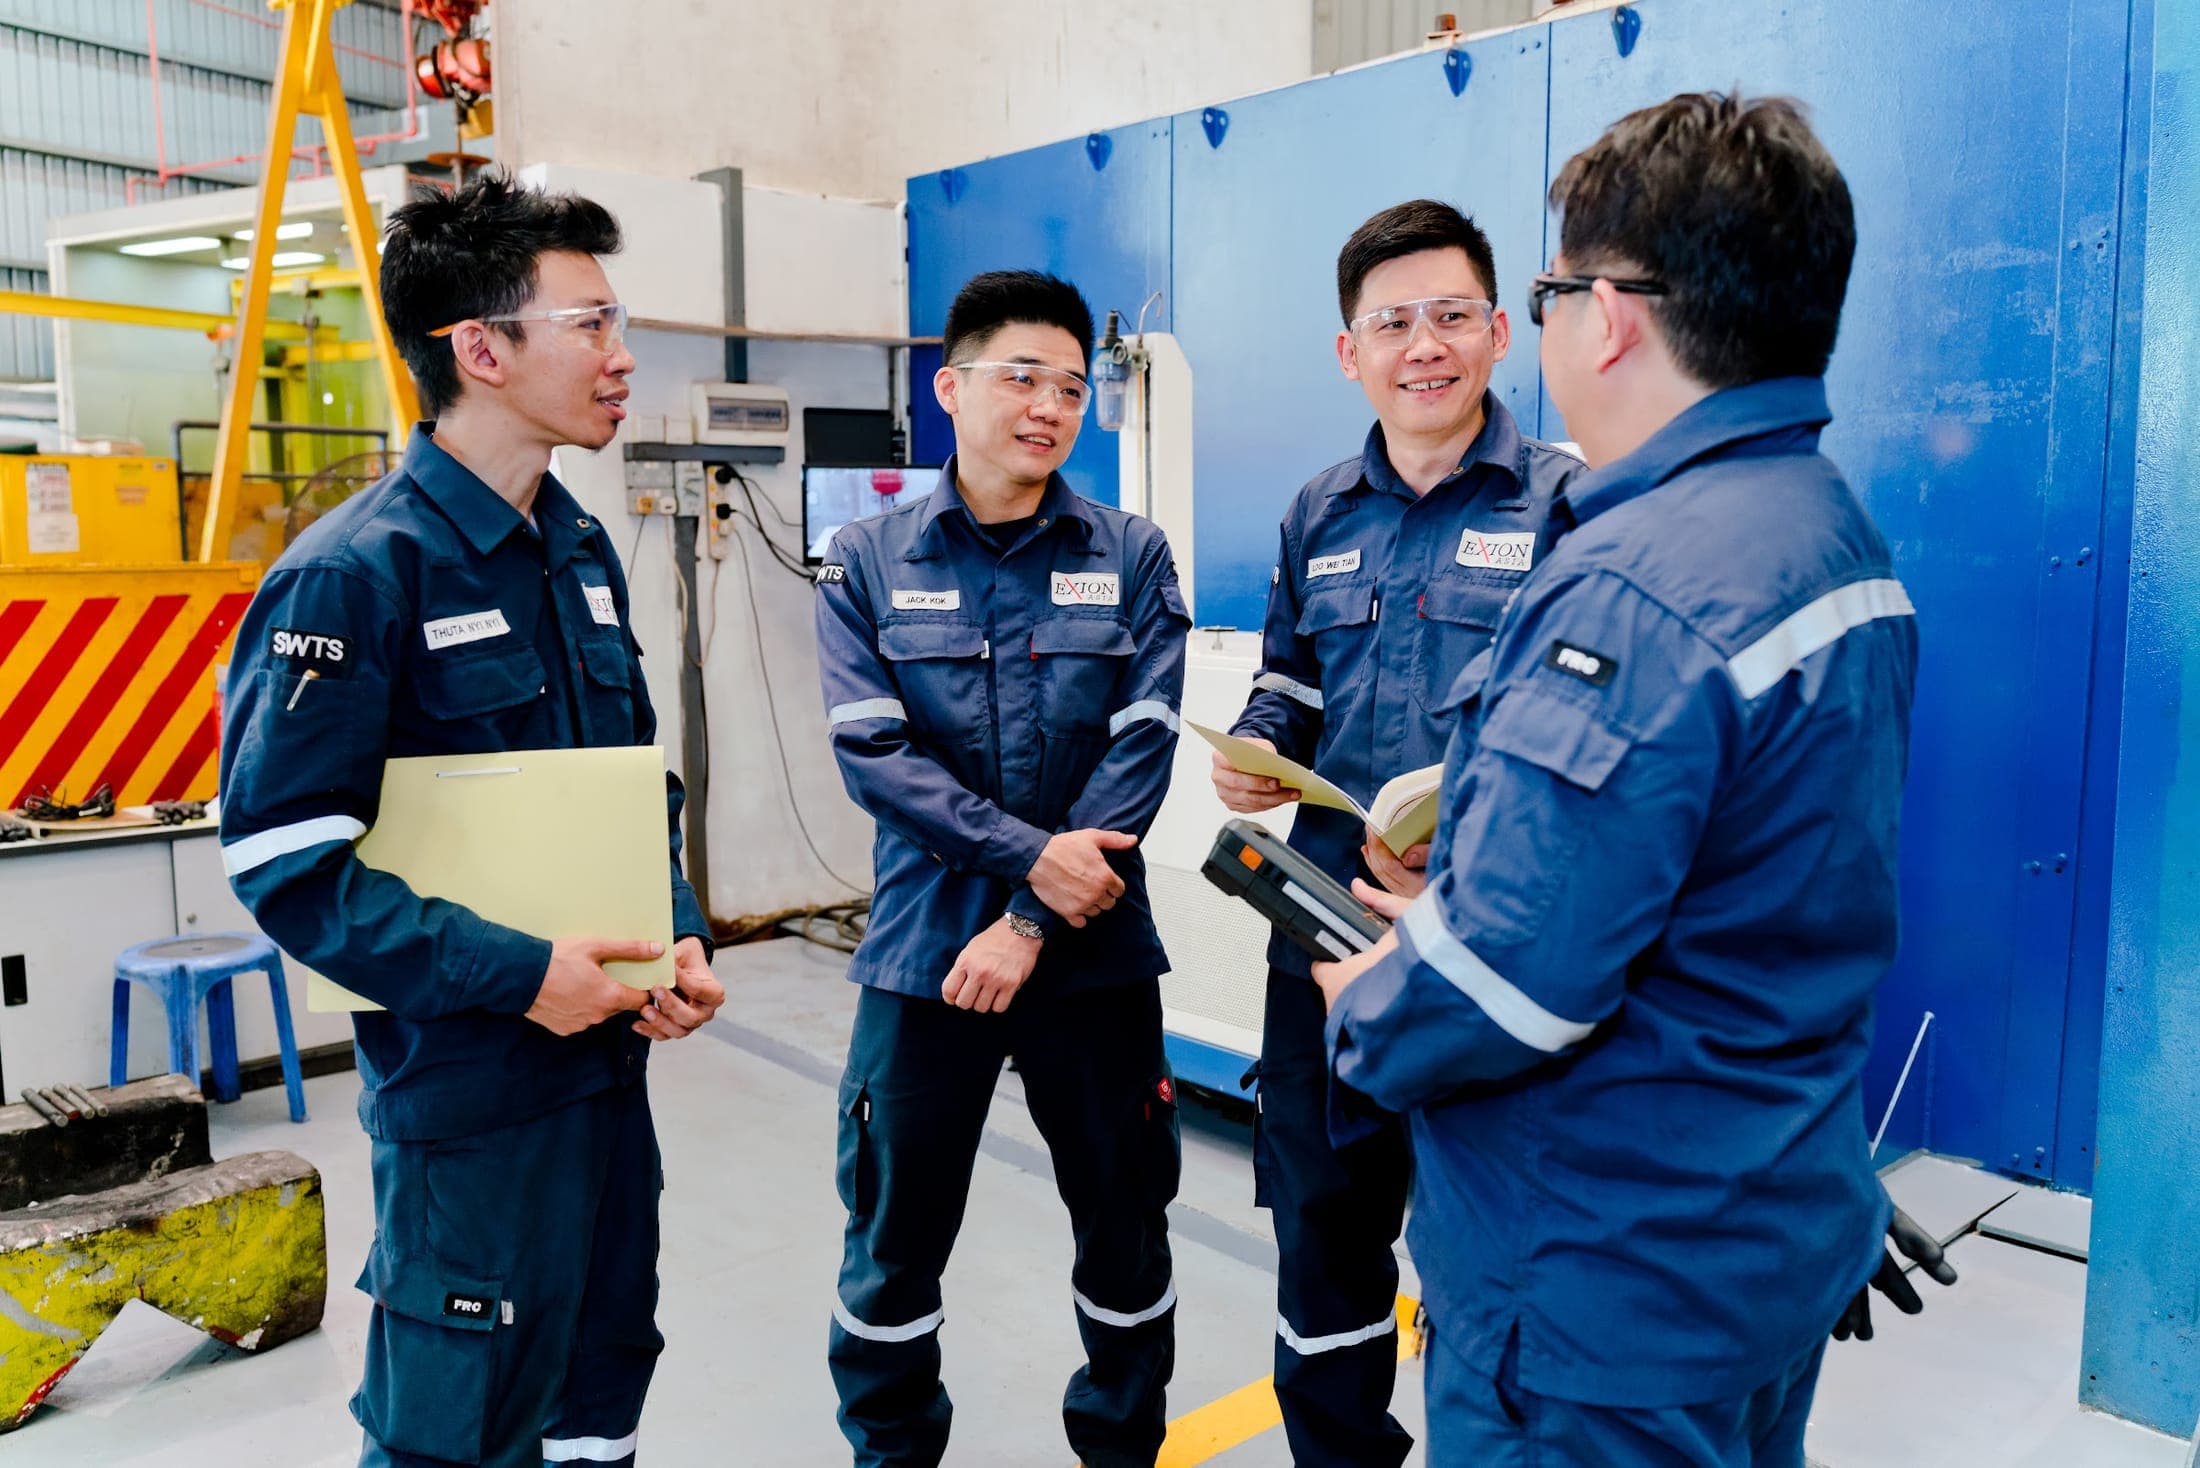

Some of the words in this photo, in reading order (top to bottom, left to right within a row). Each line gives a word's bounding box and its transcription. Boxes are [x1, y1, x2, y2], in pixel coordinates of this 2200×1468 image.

[1461, 537, 1529, 563] EXION
[1326, 560, 1340, 569] WEI
[1496, 557, 1524, 566] ASIA
[817, 565, 844, 580] WTS
[1055, 578, 1115, 600] EXION
[906, 596, 926, 604] JACK
[431, 624, 464, 640] THUTA
[273, 631, 344, 661] SWTS
